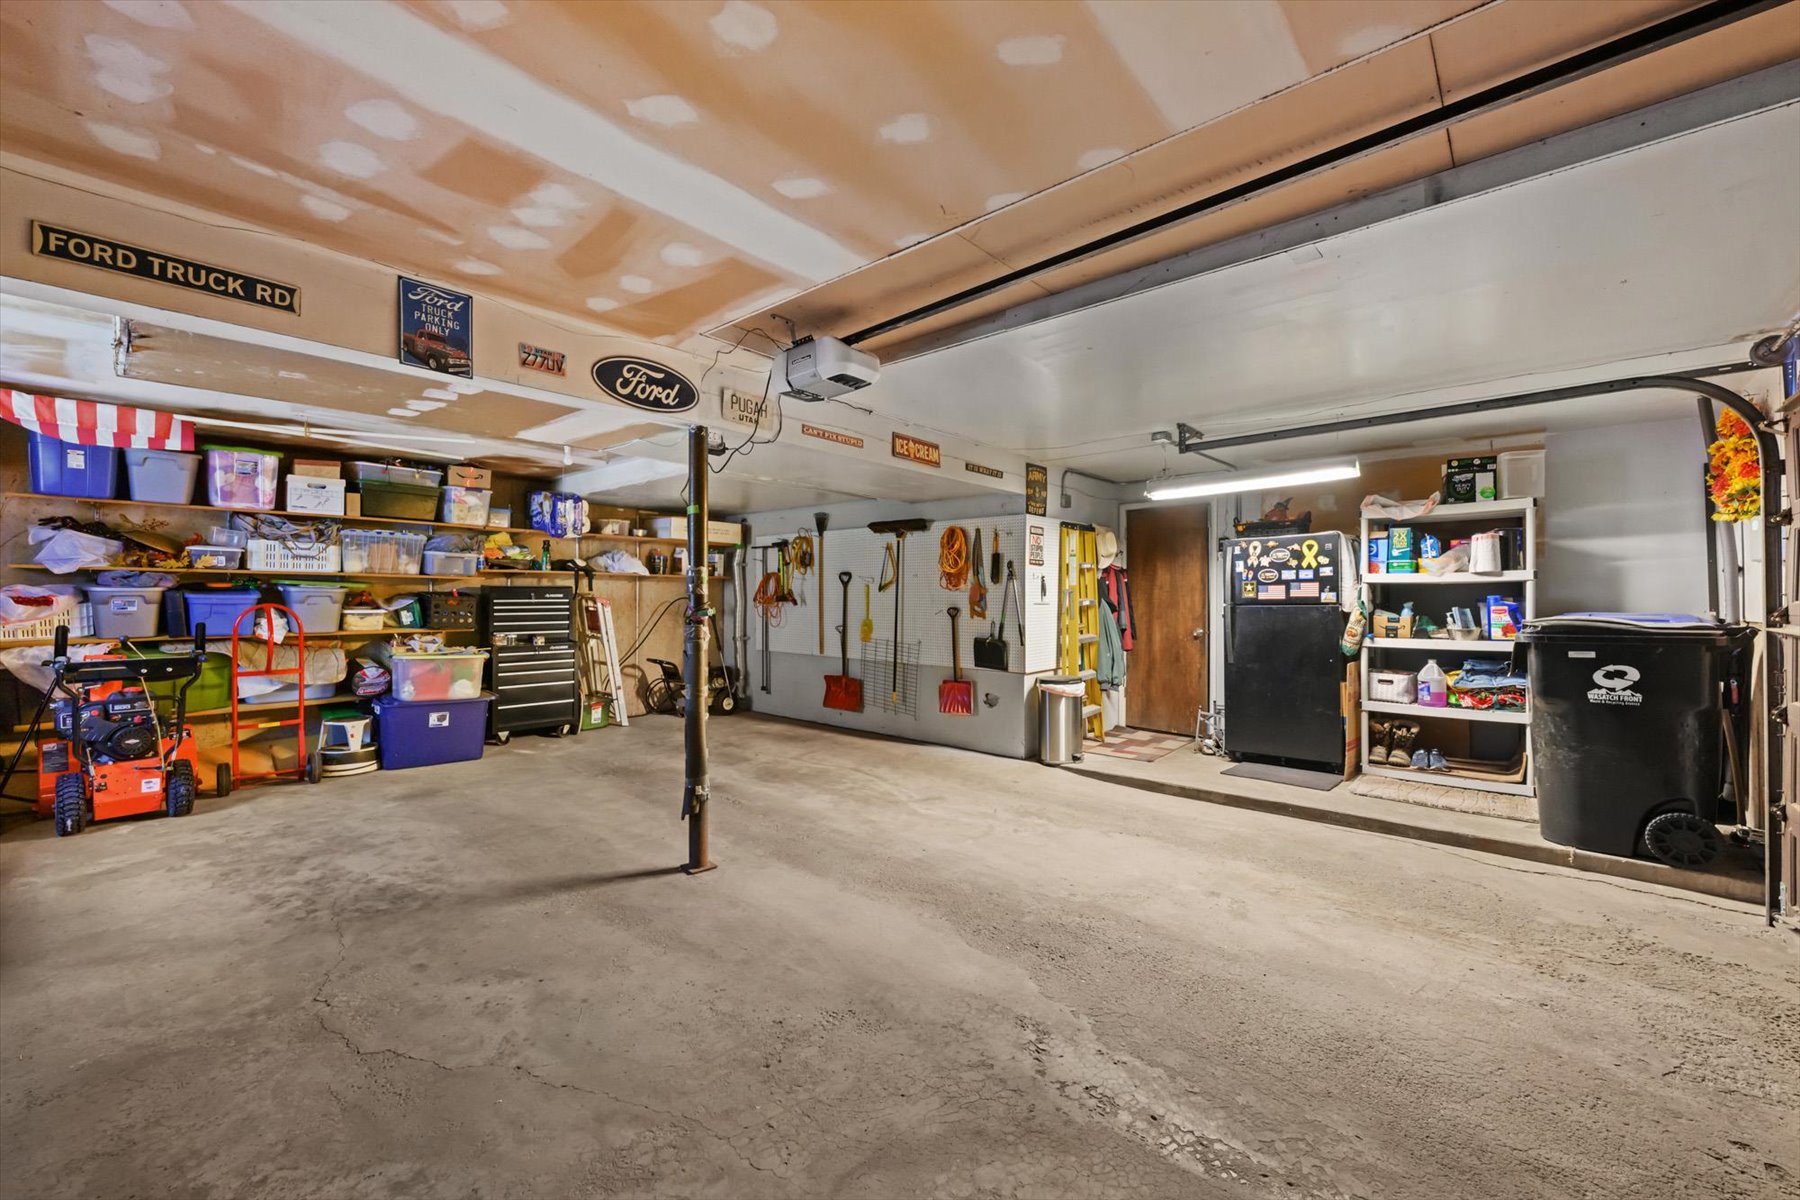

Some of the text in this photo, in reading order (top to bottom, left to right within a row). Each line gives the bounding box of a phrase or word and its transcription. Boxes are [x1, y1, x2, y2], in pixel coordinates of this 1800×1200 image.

[48, 232, 291, 307] FORD TRUCK RD
[408, 286, 464, 311] Ford
[422, 303, 453, 319] TRUCK
[414, 310, 460, 330] PARKING
[425, 322, 450, 336] ONLY
[615, 364, 680, 405] Ford
[837, 435, 863, 447] STUPID
[895, 437, 939, 463] ICE CREAM
[1028, 471, 1046, 483] ARMY
[1032, 535, 1041, 545] NO
[1588, 693, 1642, 703] WASATCH FRONT
